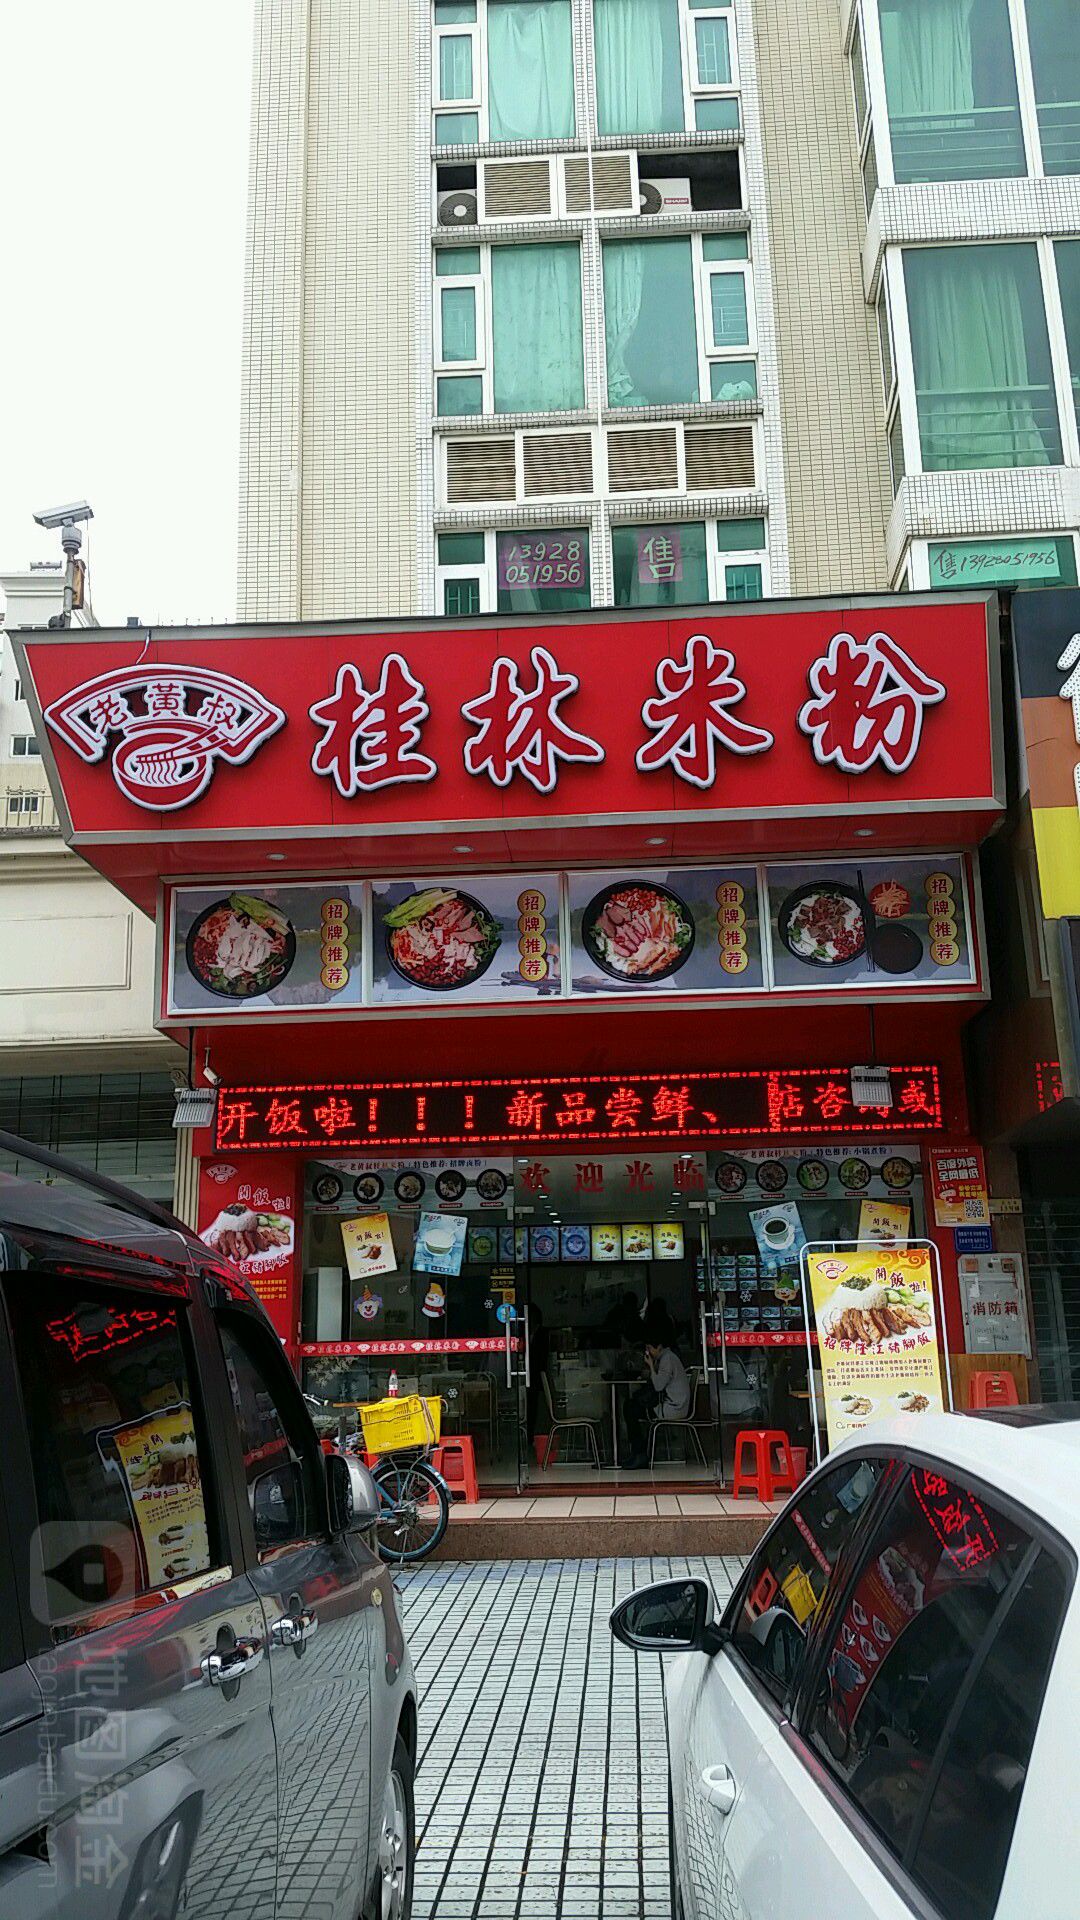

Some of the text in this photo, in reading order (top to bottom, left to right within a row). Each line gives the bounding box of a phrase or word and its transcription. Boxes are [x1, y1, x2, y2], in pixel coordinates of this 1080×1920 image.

[508, 541, 581, 562] 13928
[643, 536, 675, 580] 售
[506, 563, 582, 584] 051956
[308, 631, 948, 798] 桂林米粉
[524, 895, 543, 977] 招牌推荐
[722, 887, 743, 969] 招牌推荐
[930, 878, 954, 960] 招牌推荐
[326, 904, 344, 984] 招牌推荐
[519, 1160, 705, 1194] 欢迎光临
[936, 1157, 977, 1170] 百度外卖
[939, 1168, 980, 1182] 全网最低
[973, 1301, 1019, 1316] 消防箱
